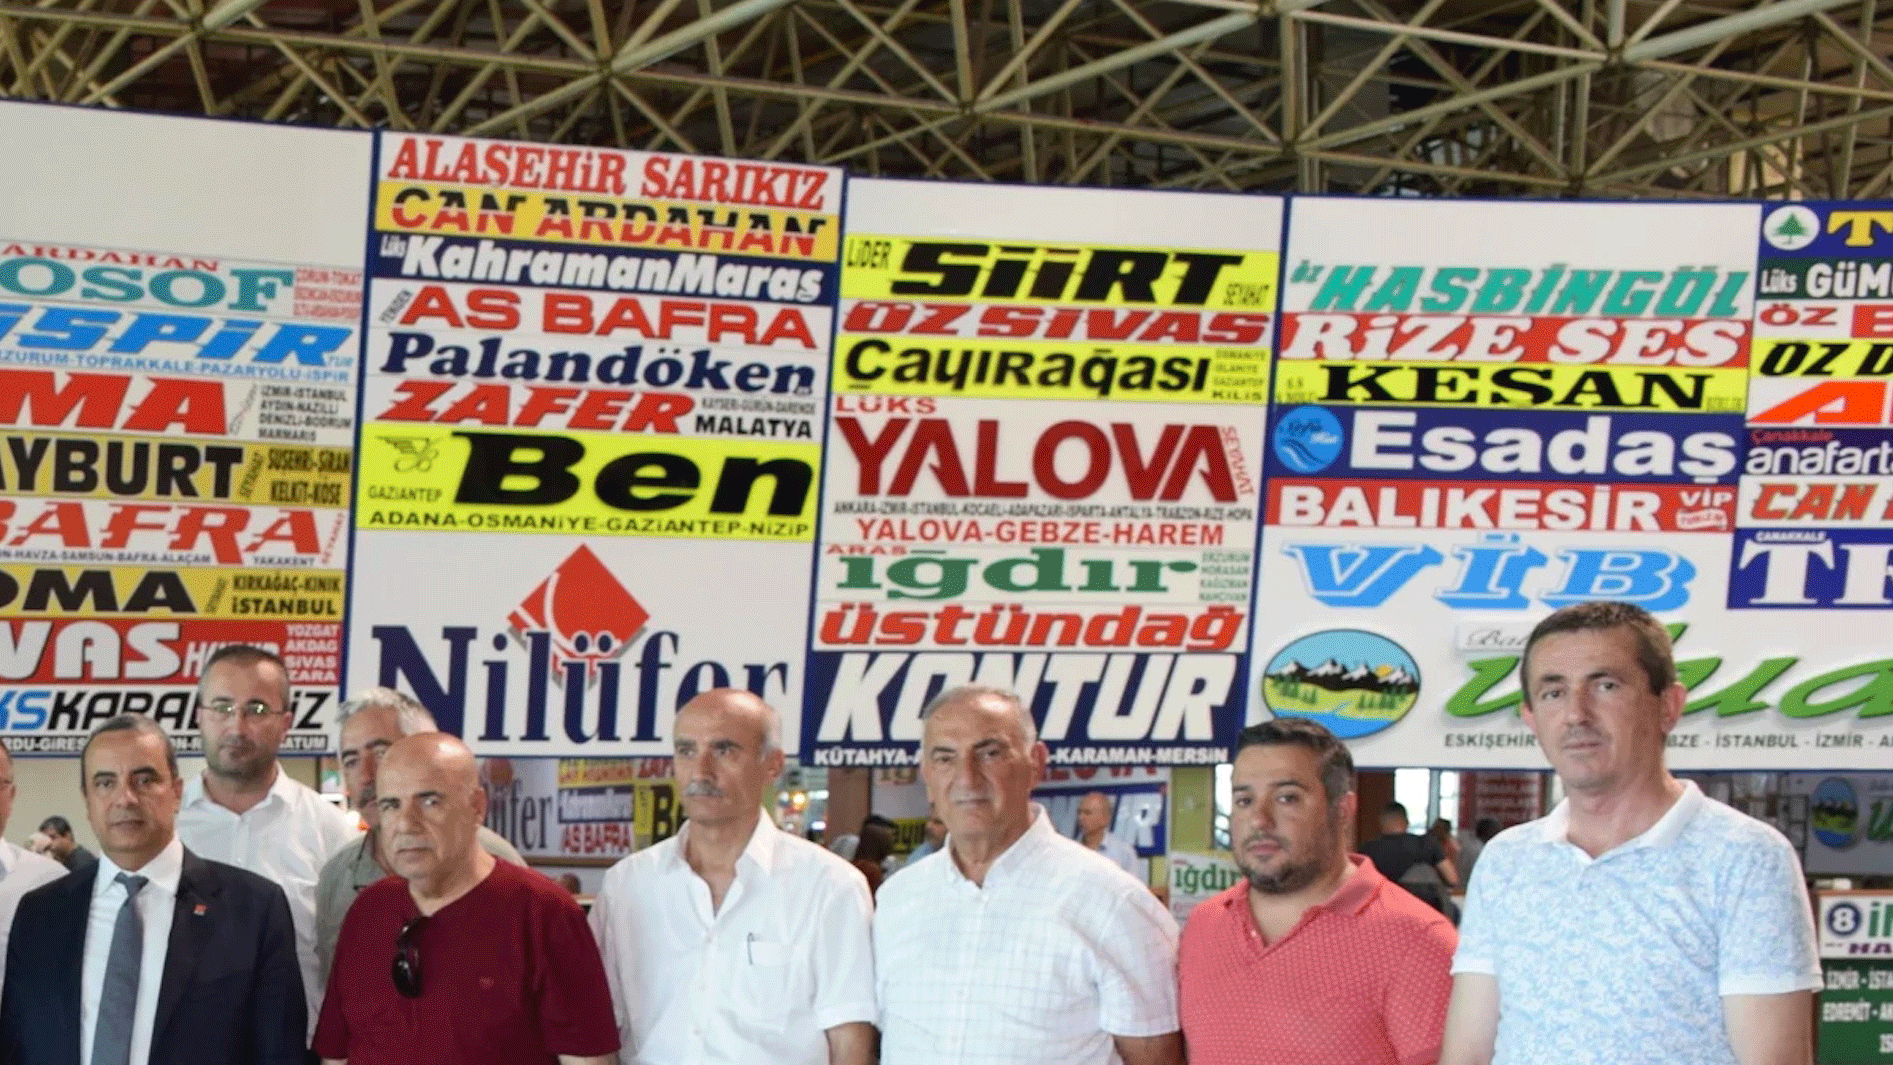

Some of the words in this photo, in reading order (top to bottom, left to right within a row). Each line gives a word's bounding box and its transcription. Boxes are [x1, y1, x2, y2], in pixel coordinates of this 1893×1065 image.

[642, 153, 829, 210] SARIKIZ
[392, 188, 527, 234] CAN
[537, 197, 826, 255] ARDAHAN
[3, 243, 219, 271] ARDAHAN
[399, 285, 521, 329] AS
[543, 293, 817, 348] BAFRA
[1760, 303, 1838, 326] ÖZ
[380, 331, 816, 394] Palandöken
[1549, 319, 1748, 367] SES
[376, 380, 696, 434] ZAFER
[695, 414, 812, 438] MALATYA
[836, 395, 937, 414] LÜKS
[835, 416, 1238, 502] YALOVA
[1350, 410, 1737, 483] Esadaş
[1746, 440, 1893, 476] anafart
[452, 431, 814, 517] Ben
[1751, 483, 1879, 520] CAN
[826, 544, 907, 555] ARAS
[856, 518, 1224, 546] YALOVA-GEBZE-HAREM
[819, 603, 1245, 652] üstündağ
[1716, 730, 1798, 748] İSTANBUL
[1816, 730, 1864, 748] İZMİR
